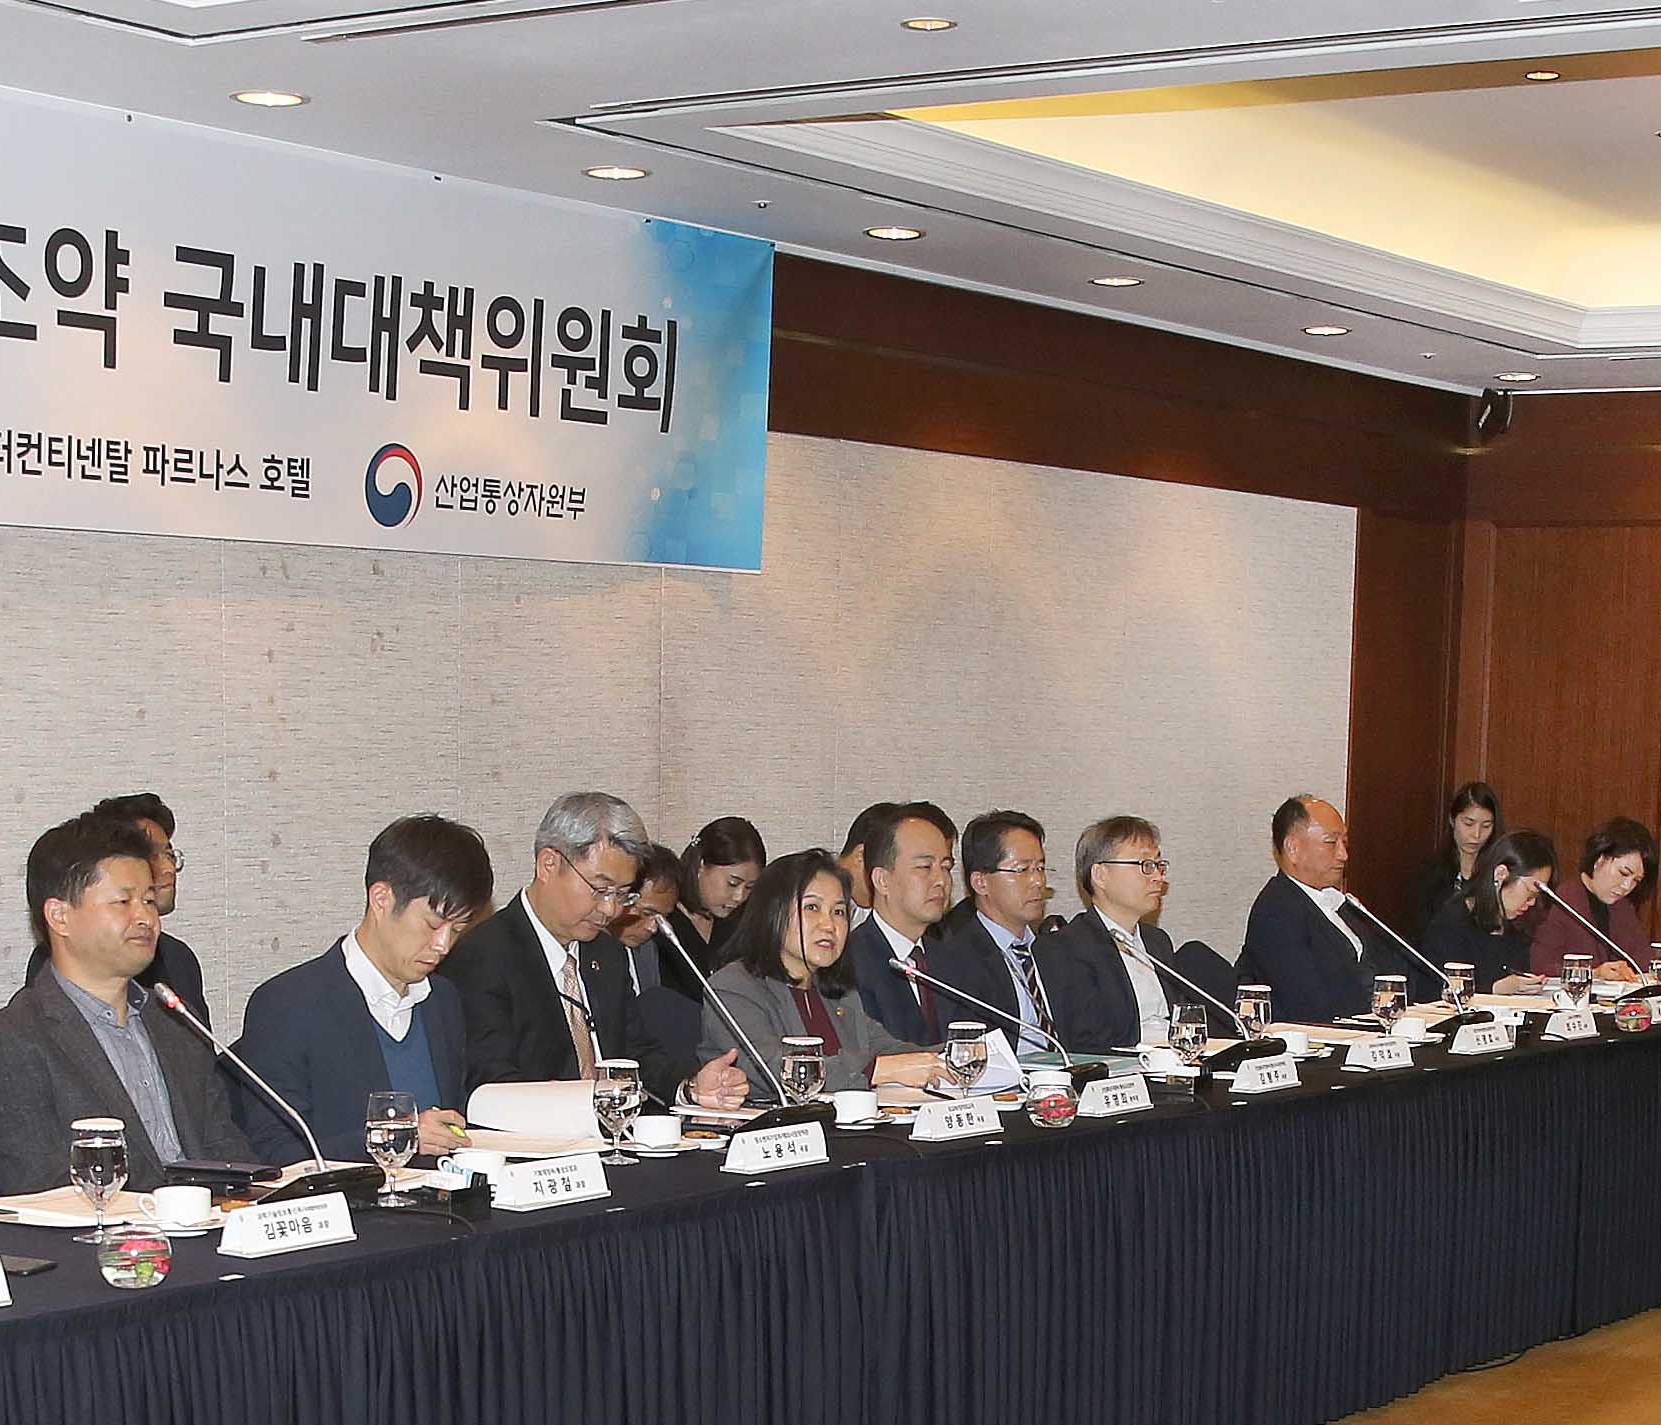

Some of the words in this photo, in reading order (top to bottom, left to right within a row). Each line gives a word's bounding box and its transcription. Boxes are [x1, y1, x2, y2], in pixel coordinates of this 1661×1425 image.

[163, 244, 679, 434] 국내대책위원회
[142, 439, 252, 494] 파르나스
[261, 454, 313, 500] 호텔
[434, 471, 587, 521] 산업통상자원부
[263, 1216, 313, 1240] 김꽃마음
